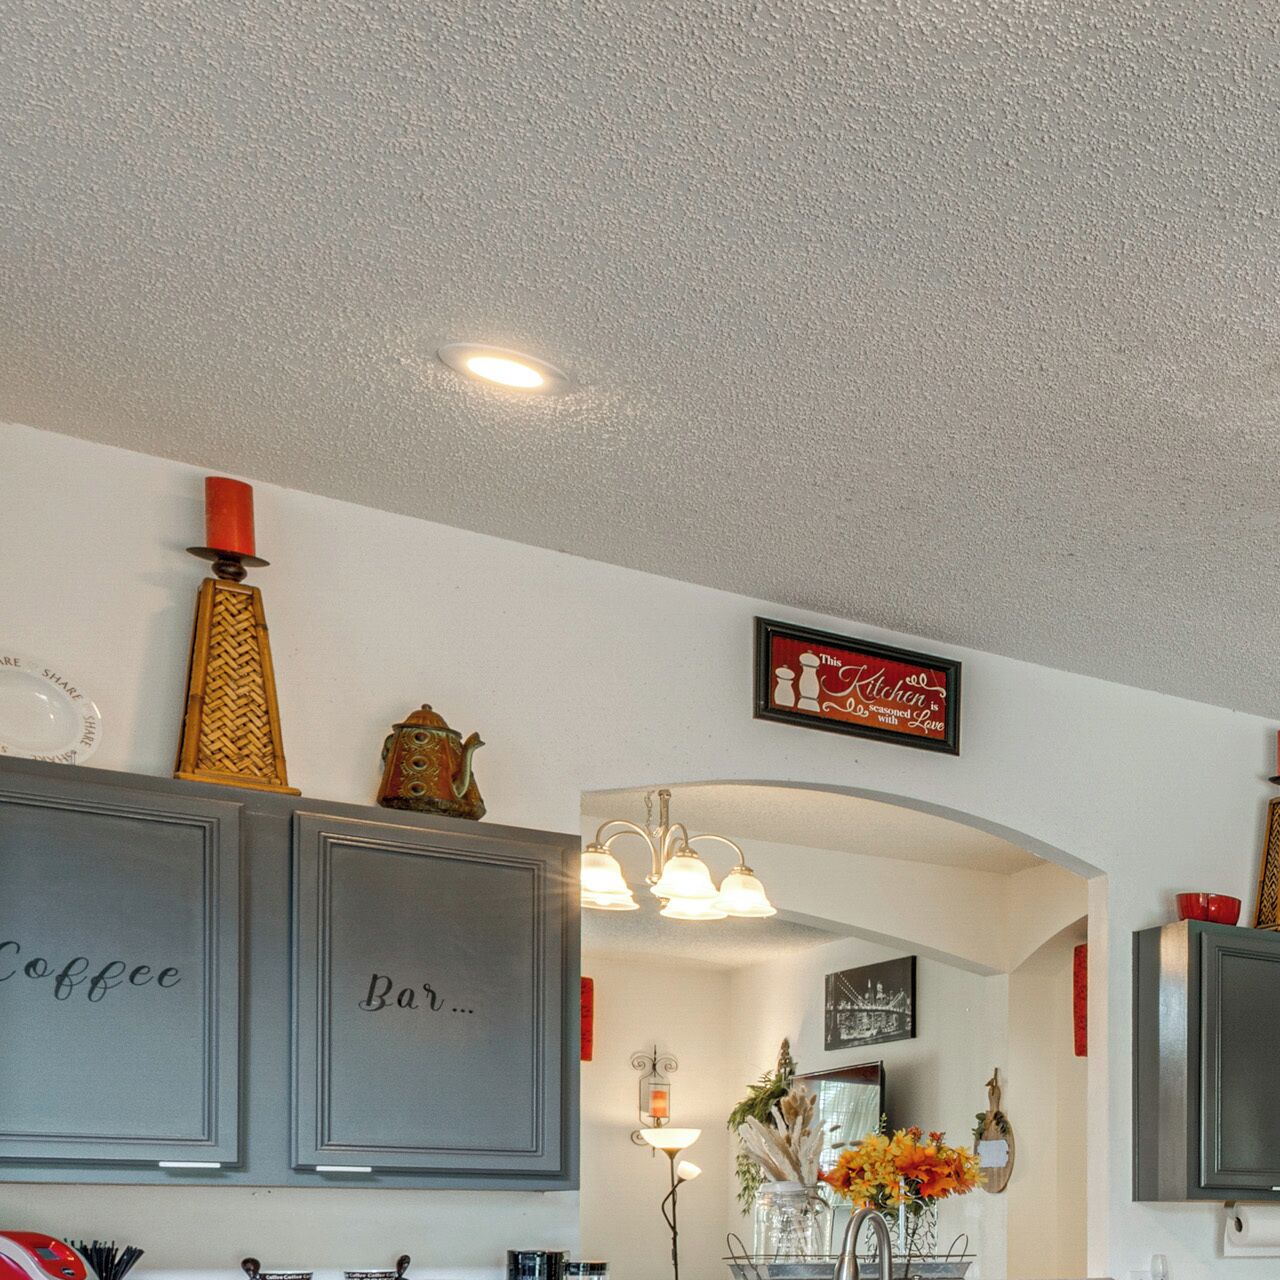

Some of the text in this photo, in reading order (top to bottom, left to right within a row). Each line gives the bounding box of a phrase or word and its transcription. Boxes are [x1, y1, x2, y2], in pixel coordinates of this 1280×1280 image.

[819, 653, 842, 667] This
[41, 669, 83, 701] SHARE
[821, 665, 938, 711] Kitchen is
[869, 704, 911, 719] seasoned
[878, 714, 898, 725] with
[908, 709, 944, 734] Love
[80, 715, 96, 748] SHARE
